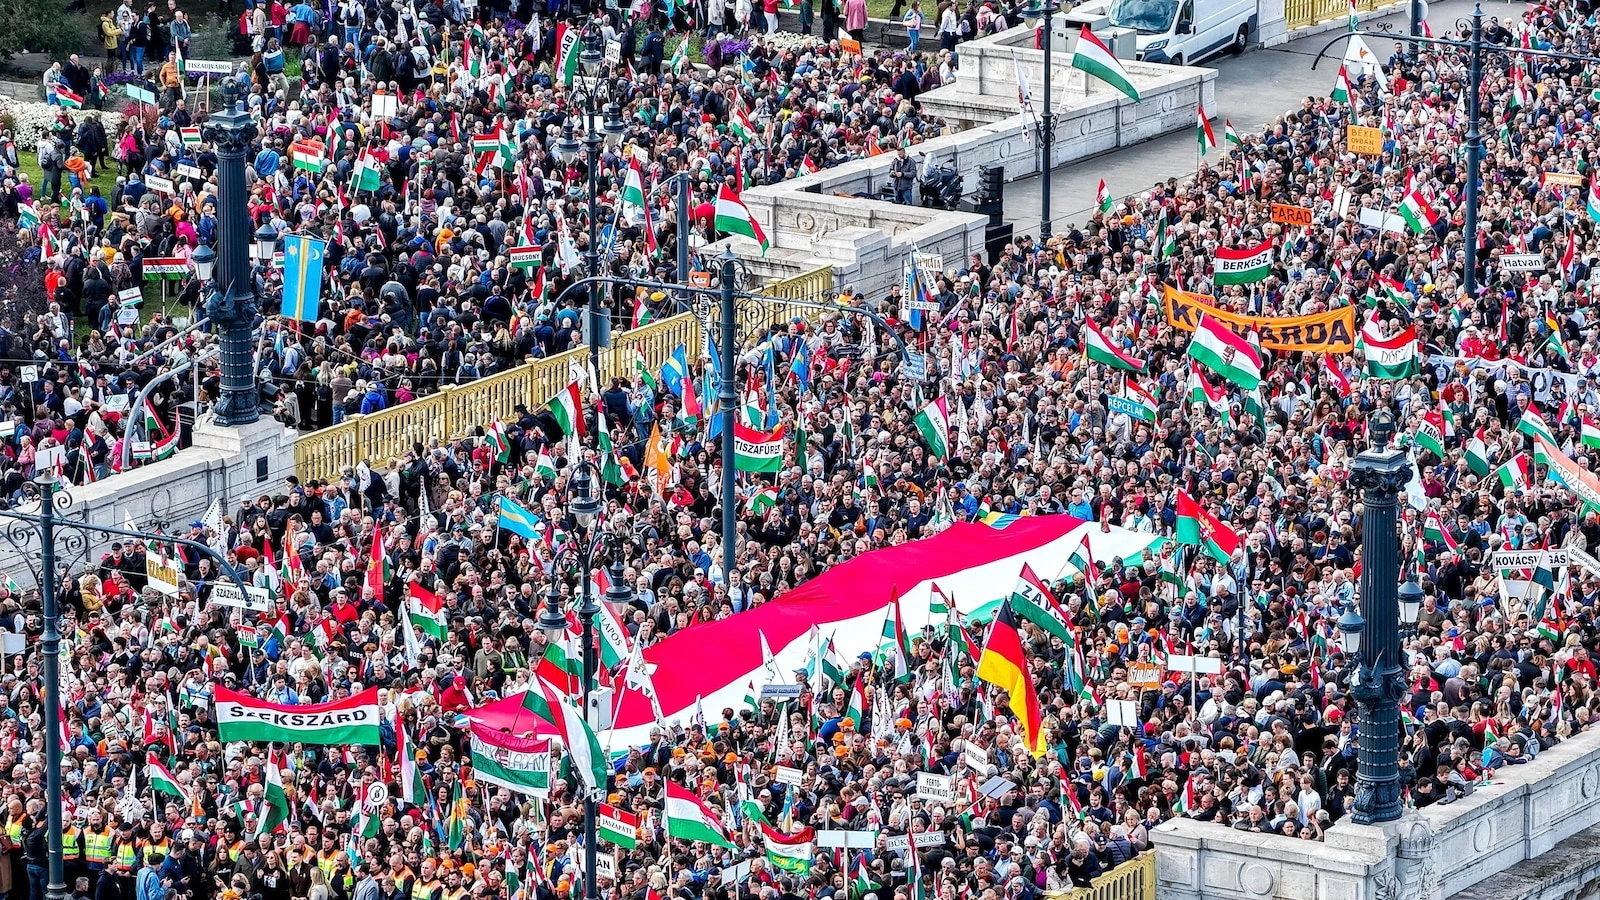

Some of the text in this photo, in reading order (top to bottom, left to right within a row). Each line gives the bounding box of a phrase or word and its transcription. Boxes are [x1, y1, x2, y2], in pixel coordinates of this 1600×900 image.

[1351, 128, 1373, 138] BÉKE
[1271, 205, 1312, 223] FARÁD
[1222, 253, 1268, 270] BERKESZ
[1503, 259, 1541, 267] Hatvan
[1108, 400, 1144, 417] RÉPCELAK
[919, 786, 949, 798] SZENTMIKLÓS
[602, 818, 632, 835] JÁSZAPÁTI
